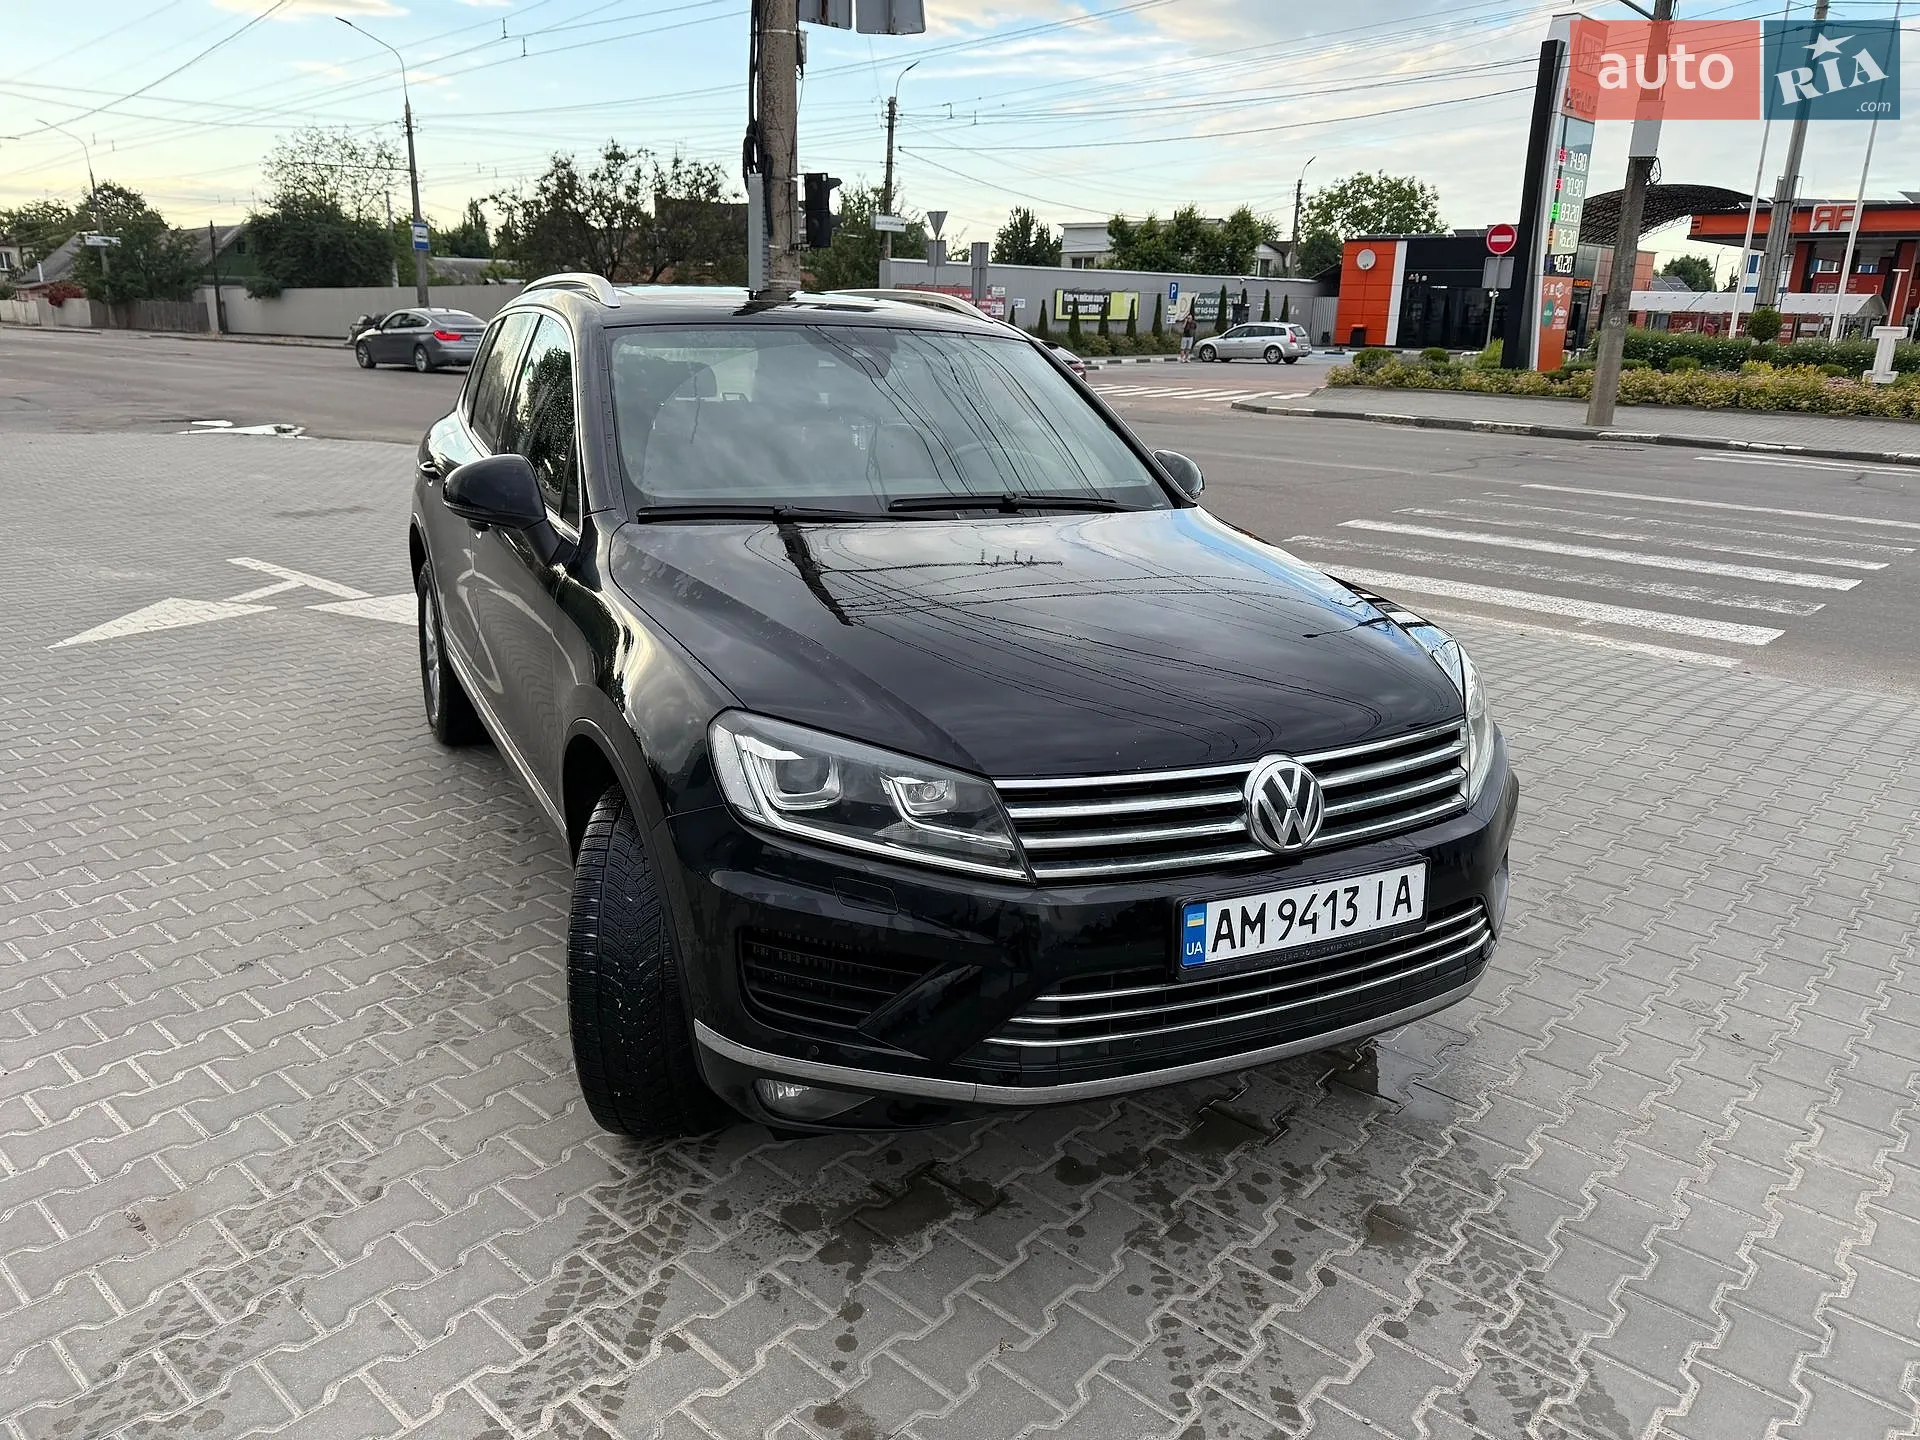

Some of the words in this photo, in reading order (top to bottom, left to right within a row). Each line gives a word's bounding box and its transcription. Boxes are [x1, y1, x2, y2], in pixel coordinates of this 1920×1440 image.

[1211, 902, 1267, 953] AM
[1277, 885, 1360, 941] 9413
[1186, 943, 1204, 956] UA
